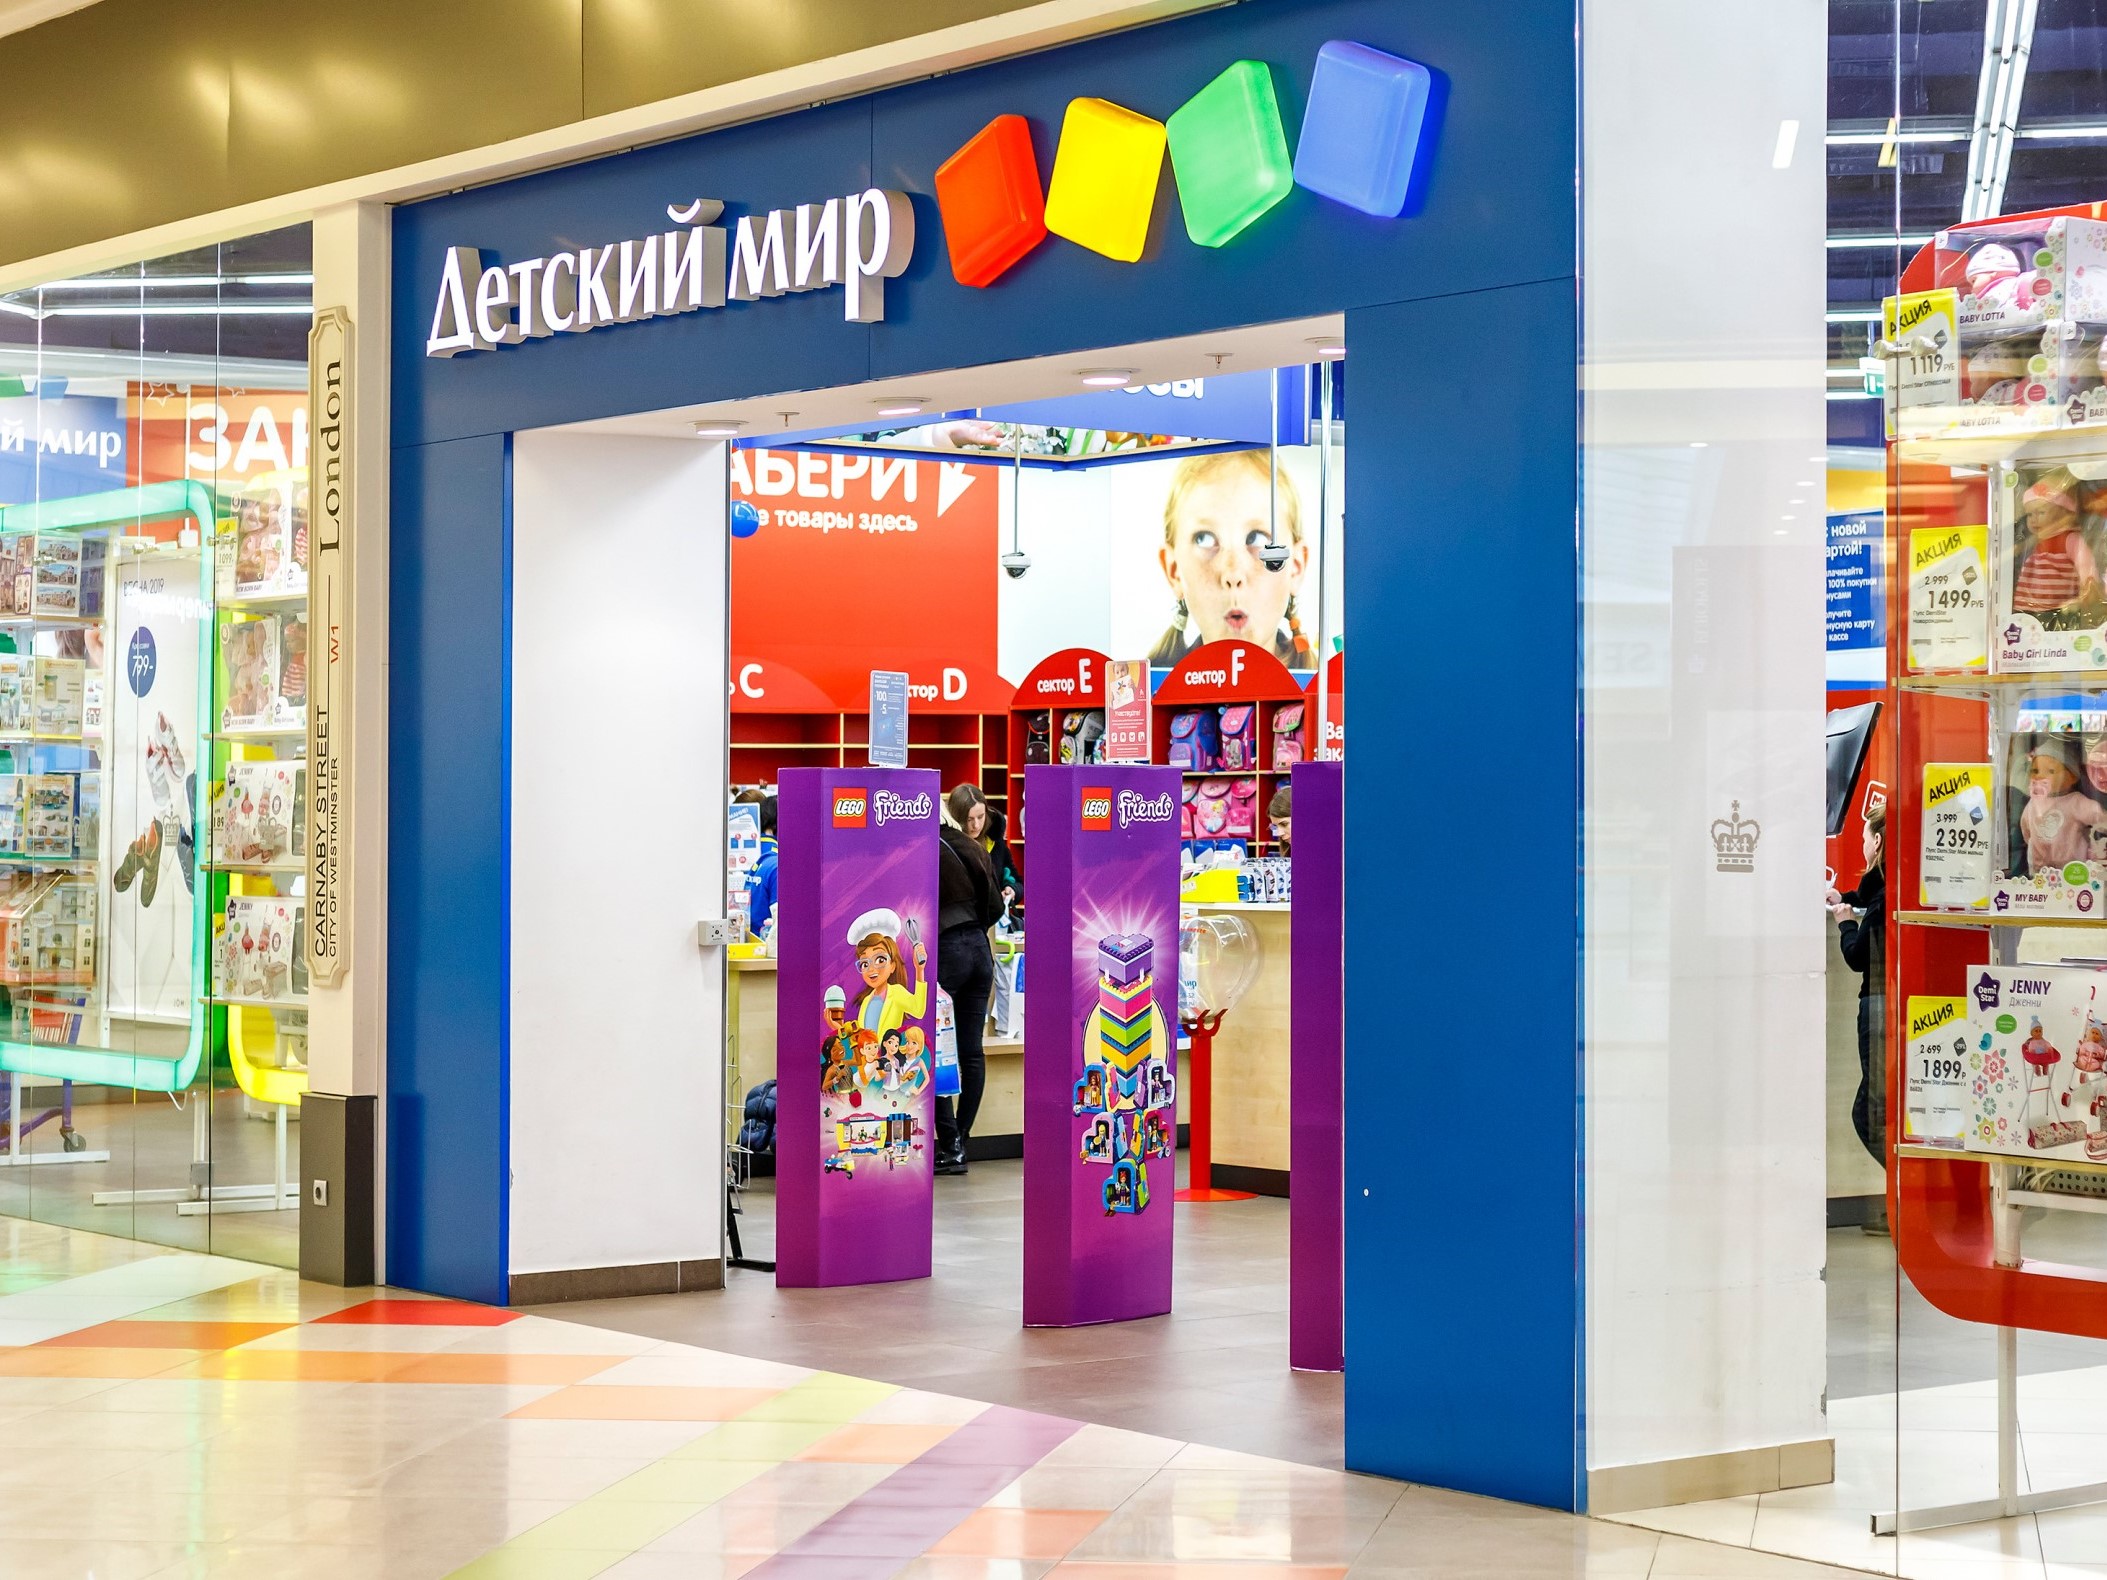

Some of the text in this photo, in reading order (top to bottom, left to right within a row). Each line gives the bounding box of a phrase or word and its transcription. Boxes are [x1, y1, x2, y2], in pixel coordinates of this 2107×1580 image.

[427, 188, 898, 357] Детский мир
[1890, 299, 1932, 336] АКЦИЯ
[1960, 312, 2005, 324] BABY LOTTA
[39, 428, 121, 468] мир
[320, 360, 341, 556] London
[774, 510, 853, 533] товары
[859, 513, 918, 534] здесь
[1831, 520, 1867, 537] новой
[1916, 533, 1962, 567] АКЦИЯ
[150, 578, 165, 594] 2019
[1847, 578, 1877, 588] покупки
[1971, 600, 1984, 608] РУБ
[1854, 620, 1876, 630] карту
[1829, 633, 1849, 641] кассе
[2003, 648, 2067, 661] Baby Girl Linda
[1037, 658, 1092, 695] сектор E
[1184, 649, 1246, 687] сектор F
[739, 663, 765, 699] C
[943, 667, 968, 701] D
[1930, 772, 1970, 802] АКЦИЯ
[834, 800, 866, 816] LEGO
[1083, 799, 1110, 818] LEGO
[315, 705, 329, 957] CARNABY STREET
[329, 757, 339, 957] CITY OF WESTMINSTER
[2015, 894, 2048, 903] MY BABY
[1978, 985, 1997, 995] Demi
[2009, 980, 2051, 995] JENNY
[1980, 994, 1995, 1002] Star
[2009, 997, 2042, 1008] Дженни
[1913, 1003, 1954, 1034] АКЦИЯ
